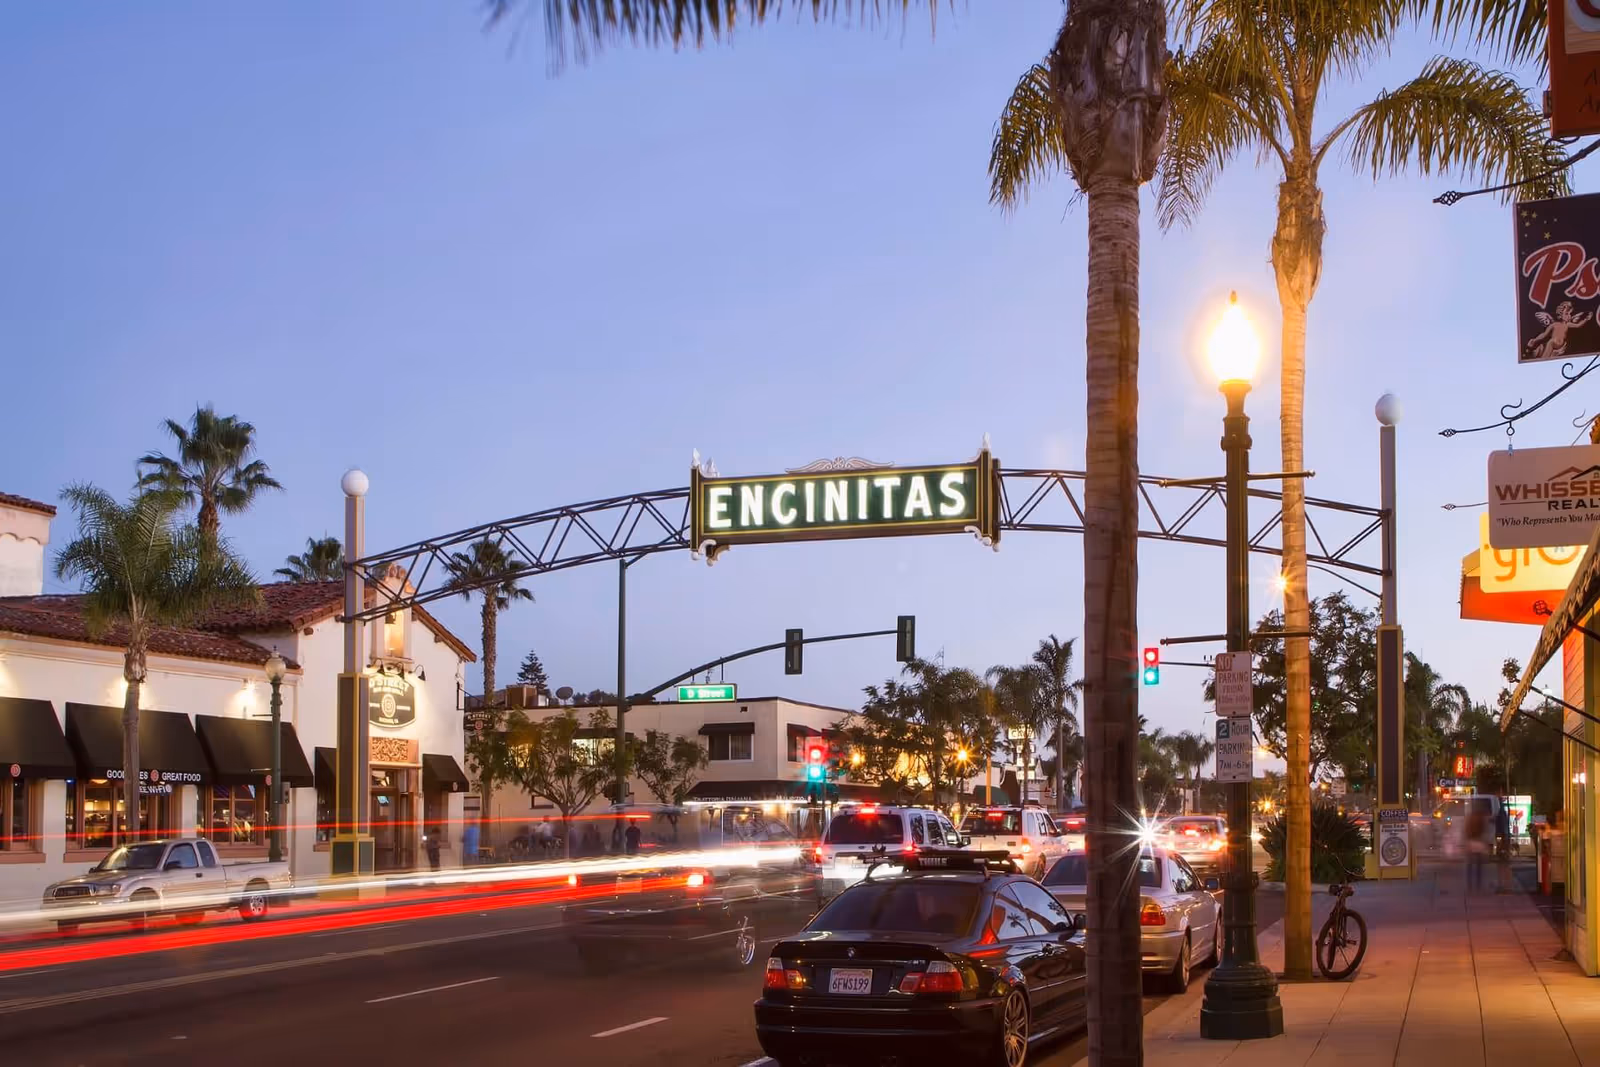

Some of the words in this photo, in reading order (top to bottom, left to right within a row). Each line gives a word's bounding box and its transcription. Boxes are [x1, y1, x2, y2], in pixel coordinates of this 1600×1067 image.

[1522, 241, 1600, 309] Ps
[1495, 480, 1600, 501] WHISSE
[708, 471, 967, 529] ENCINITAS
[1547, 497, 1600, 512] REAL
[1522, 515, 1567, 527] Represents
[1568, 513, 1583, 523] You
[1218, 656, 1232, 670] NO
[1218, 671, 1249, 684] PARKING
[697, 688, 726, 699] Street
[1219, 722, 1228, 736] 2
[1231, 724, 1249, 737] HOUR
[1219, 743, 1249, 755] PARKIN
[161, 772, 182, 781] GREAT
[183, 773, 201, 782] FOOD
[1380, 810, 1407, 818] COFFEE
[918, 857, 948, 866] THULE
